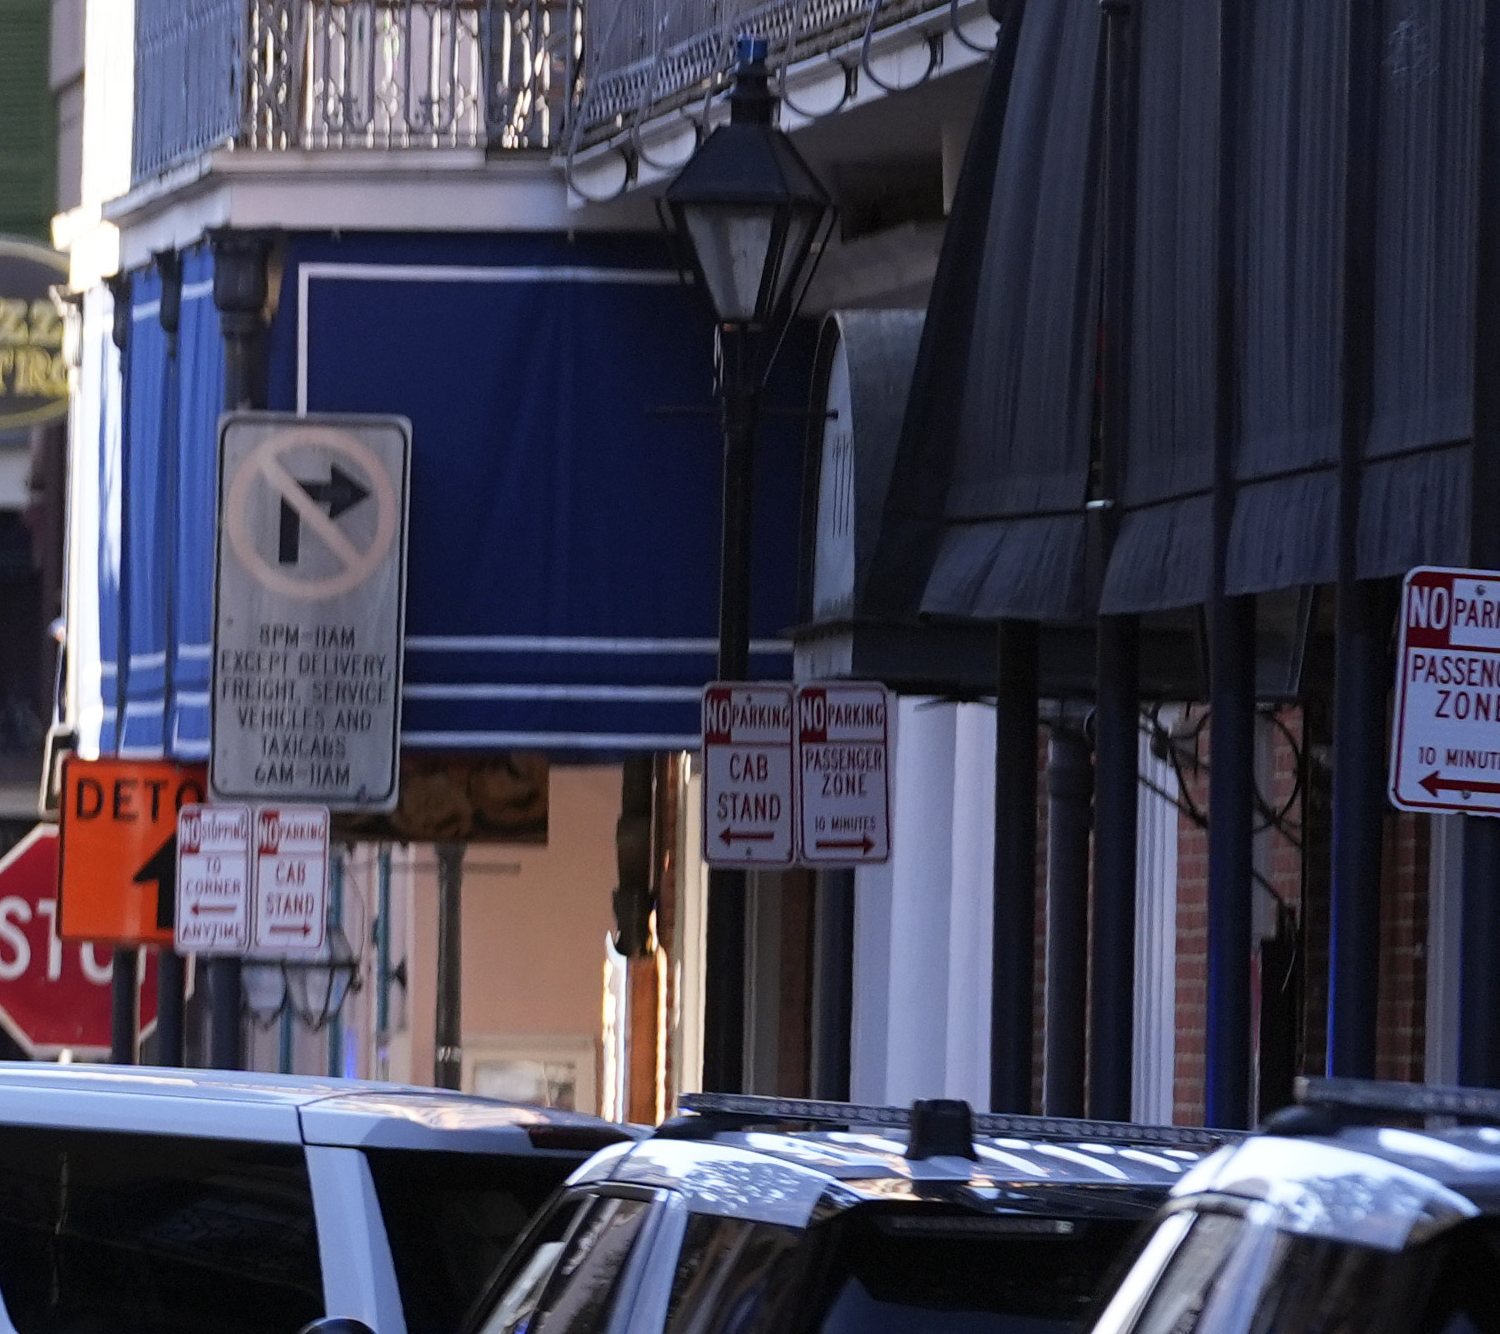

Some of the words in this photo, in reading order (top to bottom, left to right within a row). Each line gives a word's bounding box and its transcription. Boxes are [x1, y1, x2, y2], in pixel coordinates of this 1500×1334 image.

[1408, 585, 1450, 630] NO
[1454, 597, 1500, 629] PAR
[220, 650, 288, 675] EXCEPT
[1411, 653, 1500, 688] PASSEN
[311, 679, 386, 705] SERVICE
[238, 705, 325, 733] VEHICLES
[333, 706, 373, 733] AND
[706, 696, 731, 734] NO
[732, 704, 790, 729] PARKING
[801, 696, 826, 733] NO
[827, 703, 884, 729] PARKING
[261, 732, 347, 760] TAXICABS
[804, 746, 882, 772] PASSENGER
[1418, 745, 1437, 766] 10
[1445, 748, 1500, 770] MINUT
[728, 752, 769, 783] CAB
[821, 773, 869, 798] ZONE
[717, 792, 781, 824] STAND
[180, 816, 201, 848] NO
[201, 819, 247, 841] STOPPING
[259, 816, 279, 849] NO
[279, 821, 325, 843] PARKING
[814, 815, 826, 832] 10
[830, 815, 877, 834] MINUTES
[206, 855, 222, 874] TO
[275, 861, 306, 887] CAB
[185, 878, 241, 898] CORNER
[265, 891, 316, 917] STAND
[182, 921, 244, 944] ANYTIME
